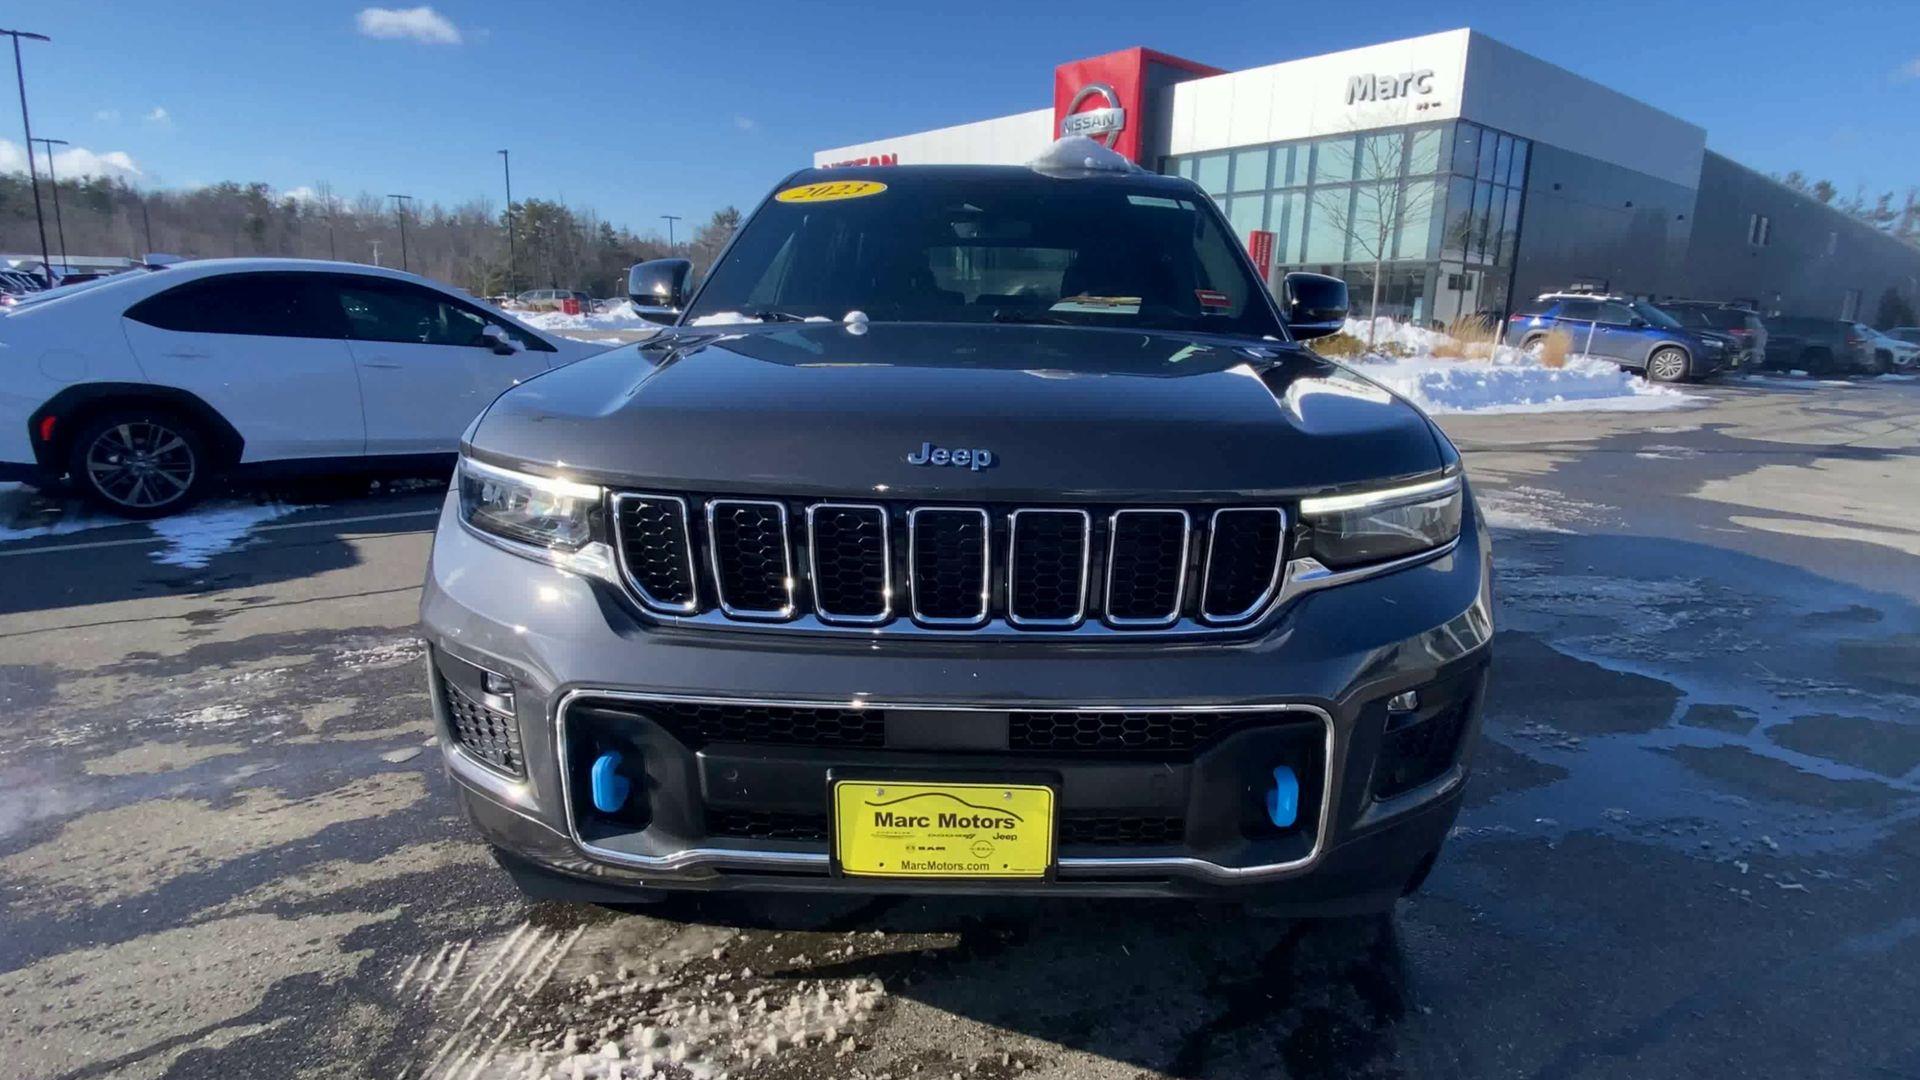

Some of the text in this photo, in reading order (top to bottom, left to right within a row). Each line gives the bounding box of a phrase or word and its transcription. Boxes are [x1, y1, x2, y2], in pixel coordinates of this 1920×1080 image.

[1345, 68, 1434, 105] Marc
[1064, 113, 1115, 132] NISSAN
[791, 183, 870, 200] 2023
[907, 442, 992, 471] Jeep
[874, 812, 1016, 829] Marc Motors
[993, 832, 1018, 841] Jeep
[901, 861, 990, 871] MarcMotors.com
